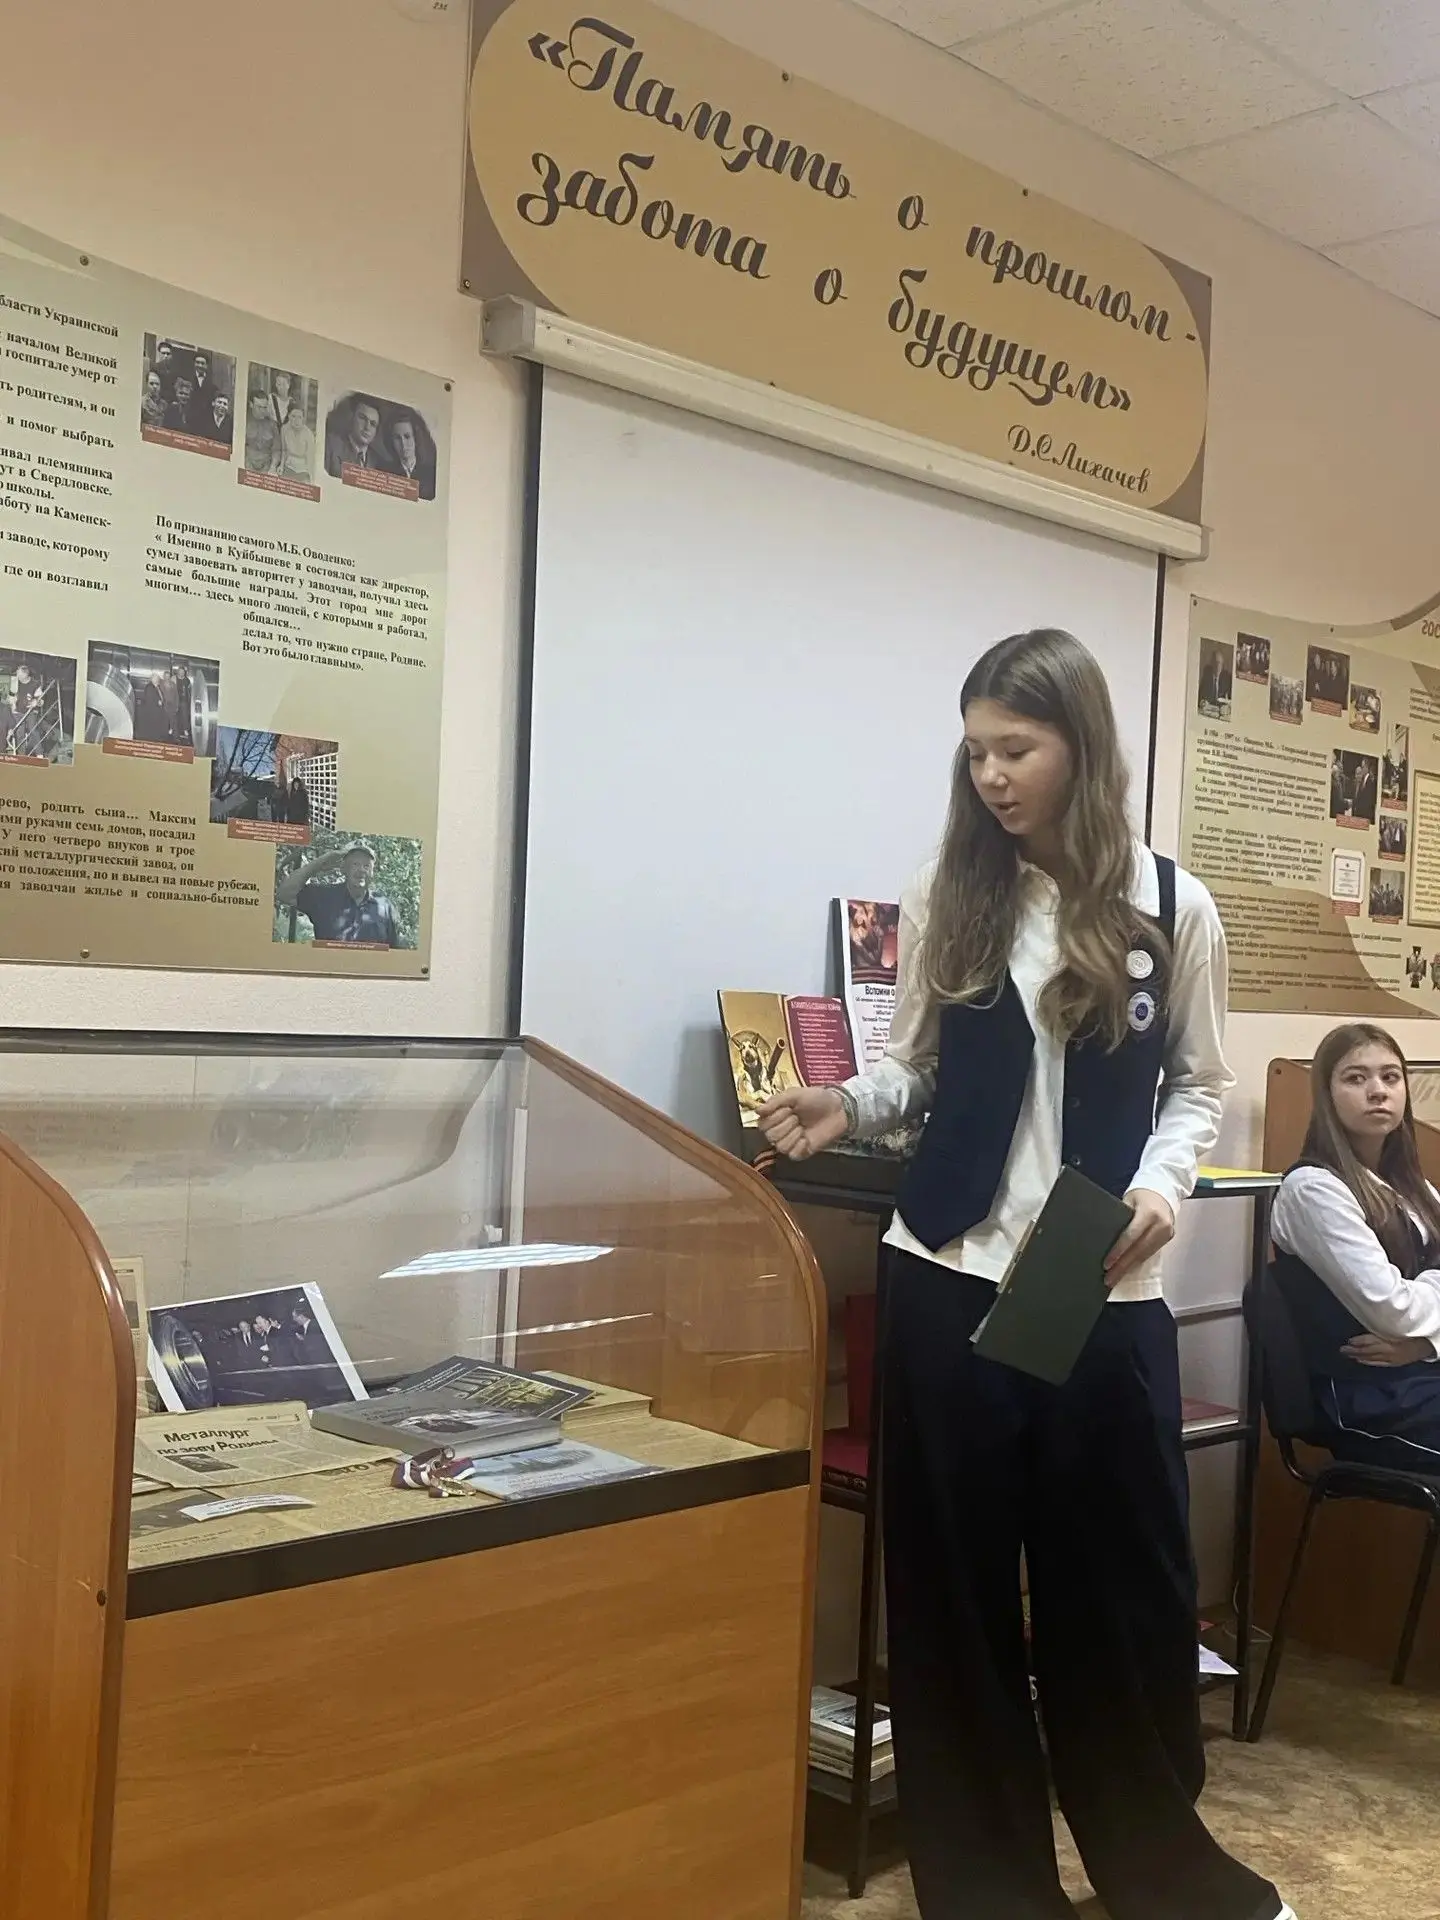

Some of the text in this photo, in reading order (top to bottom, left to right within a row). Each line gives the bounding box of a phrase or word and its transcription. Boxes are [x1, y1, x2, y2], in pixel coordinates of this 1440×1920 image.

[526, 17, 858, 200] «Память
[897, 194, 929, 231] о
[965, 221, 1172, 343] прошлом
[515, 152, 1132, 413] забота о будущем»
[44, 306, 119, 337] Украинской
[7, 332, 118, 369] началом Великой
[5, 349, 118, 385] госпитале умер от
[17, 385, 87, 411] родителям,
[90, 403, 98, 412] и
[101, 406, 115, 417] он
[7, 416, 114, 448] и помог выбрать
[19, 468, 26, 477] в
[30, 468, 113, 496] Свердловске.
[37, 455, 113, 480] племянника
[6, 482, 55, 500] школы.
[35, 504, 50, 515] на
[54, 505, 111, 528] Каменск-
[6, 532, 110, 562] заводе, которому
[156, 515, 355, 568] По признанию самого М.Б. Оводенко:
[4, 565, 108, 591] где он возглавил
[146, 547, 180, 562] сумел
[183, 553, 238, 573] завоевать
[241, 566, 295, 585] авторитет
[307, 580, 357, 598] заводчан,
[360, 589, 401, 606] получил
[404, 599, 429, 612] здесь
[167, 532, 211, 552] Именно
[216, 545, 223, 554] в
[228, 545, 291, 569] Куйбышеве
[295, 562, 302, 571] я
[306, 564, 356, 582] состоялся
[360, 575, 379, 586] как
[381, 581, 429, 598] директор,
[145, 563, 428, 626] самые большие награды. Этот город мне дорог
[205, 589, 234, 603] здесь
[238, 596, 271, 610] много
[274, 604, 310, 619] людей,
[322, 612, 374, 630] которыми
[387, 625, 428, 641] работал,
[242, 627, 427, 668] делал то, что нужно стране, Родине.
[242, 641, 261, 653] Вот
[262, 646, 280, 657] это
[281, 647, 310, 661] было
[26, 816, 72, 829] руками
[76, 821, 104, 832] семь
[107, 825, 145, 836] домов,
[149, 828, 195, 840] посадил
[41, 802, 85, 814] родить
[149, 810, 196, 825] Максим
[2, 828, 12, 840] У
[19, 832, 46, 843] него
[53, 835, 101, 850] четверо
[107, 840, 149, 852] внуков
[170, 846, 196, 857] трое
[24, 849, 139, 867] металлургический
[143, 859, 177, 871] завод,
[181, 863, 194, 871] он
[19, 865, 91, 880] положения,
[93, 871, 108, 880] но
[122, 873, 159, 884] вывел
[163, 876, 176, 886] на
[180, 877, 215, 889] новые
[217, 879, 260, 892] рубежи,
[20, 881, 76, 894] заводчан
[84, 886, 123, 897] жилье
[147, 890, 260, 907] социально-бытовые
[163, 1429, 250, 1443] Металлург
